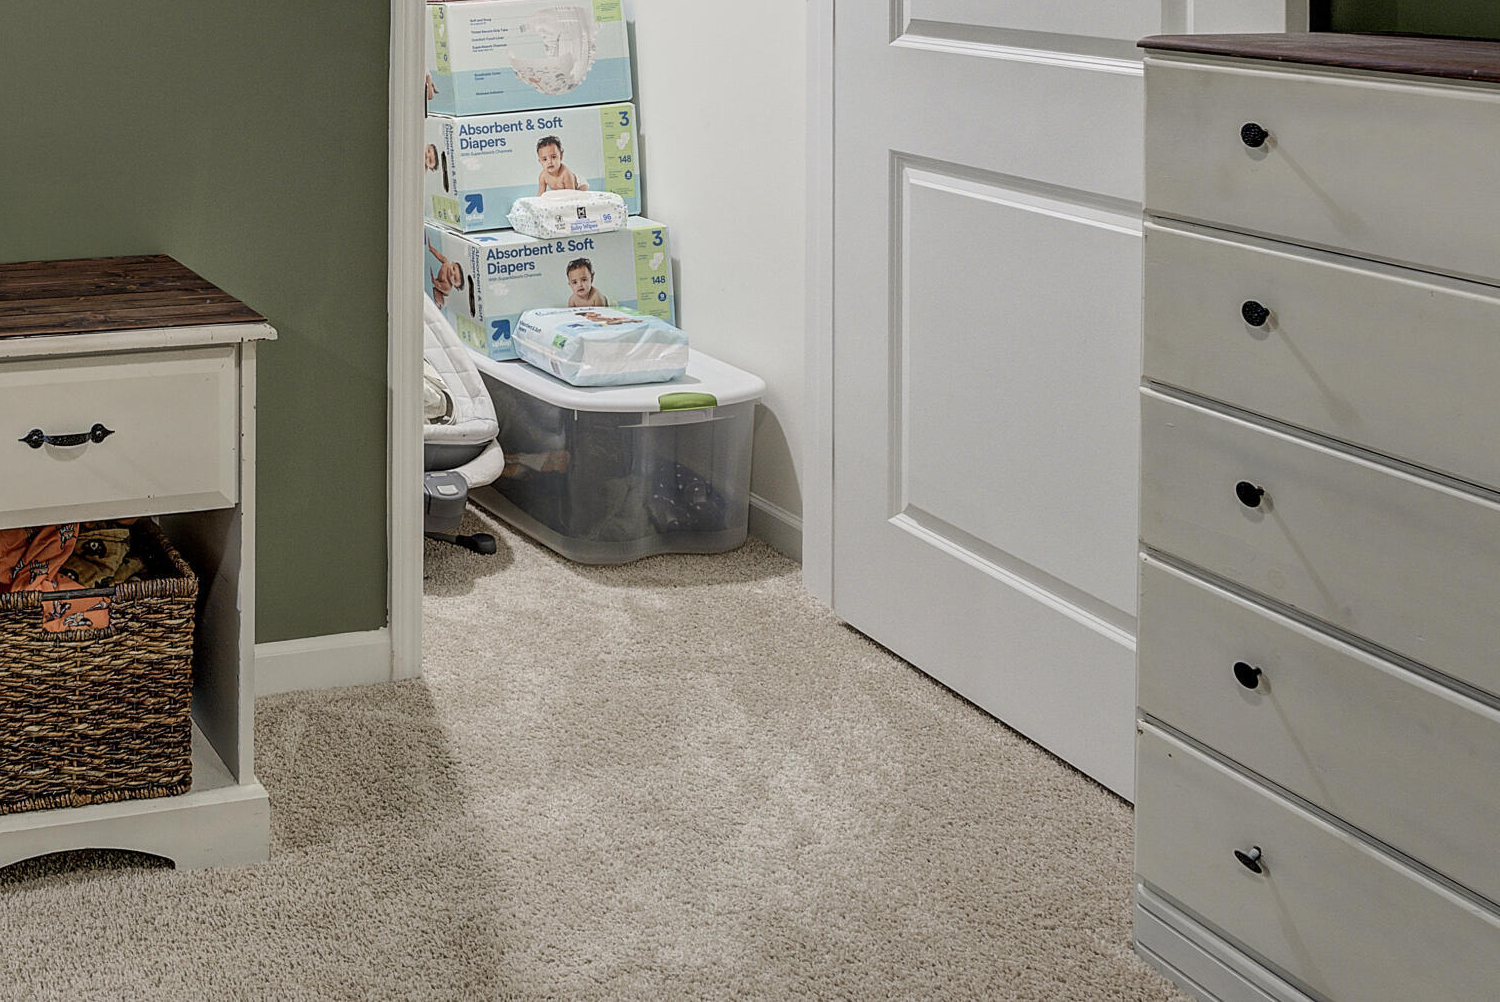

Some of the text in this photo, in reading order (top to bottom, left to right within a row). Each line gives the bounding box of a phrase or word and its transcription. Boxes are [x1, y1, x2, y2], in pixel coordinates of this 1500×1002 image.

[438, 7, 444, 19] 3
[619, 111, 629, 126] 3
[459, 116, 563, 136] Absorbent & Soft
[460, 137, 506, 150] Diapers
[618, 155, 631, 163] 148
[652, 230, 663, 246] 3
[487, 238, 594, 260] Absorbent & Soft
[488, 261, 535, 275] Diapers
[652, 275, 665, 284] 148
